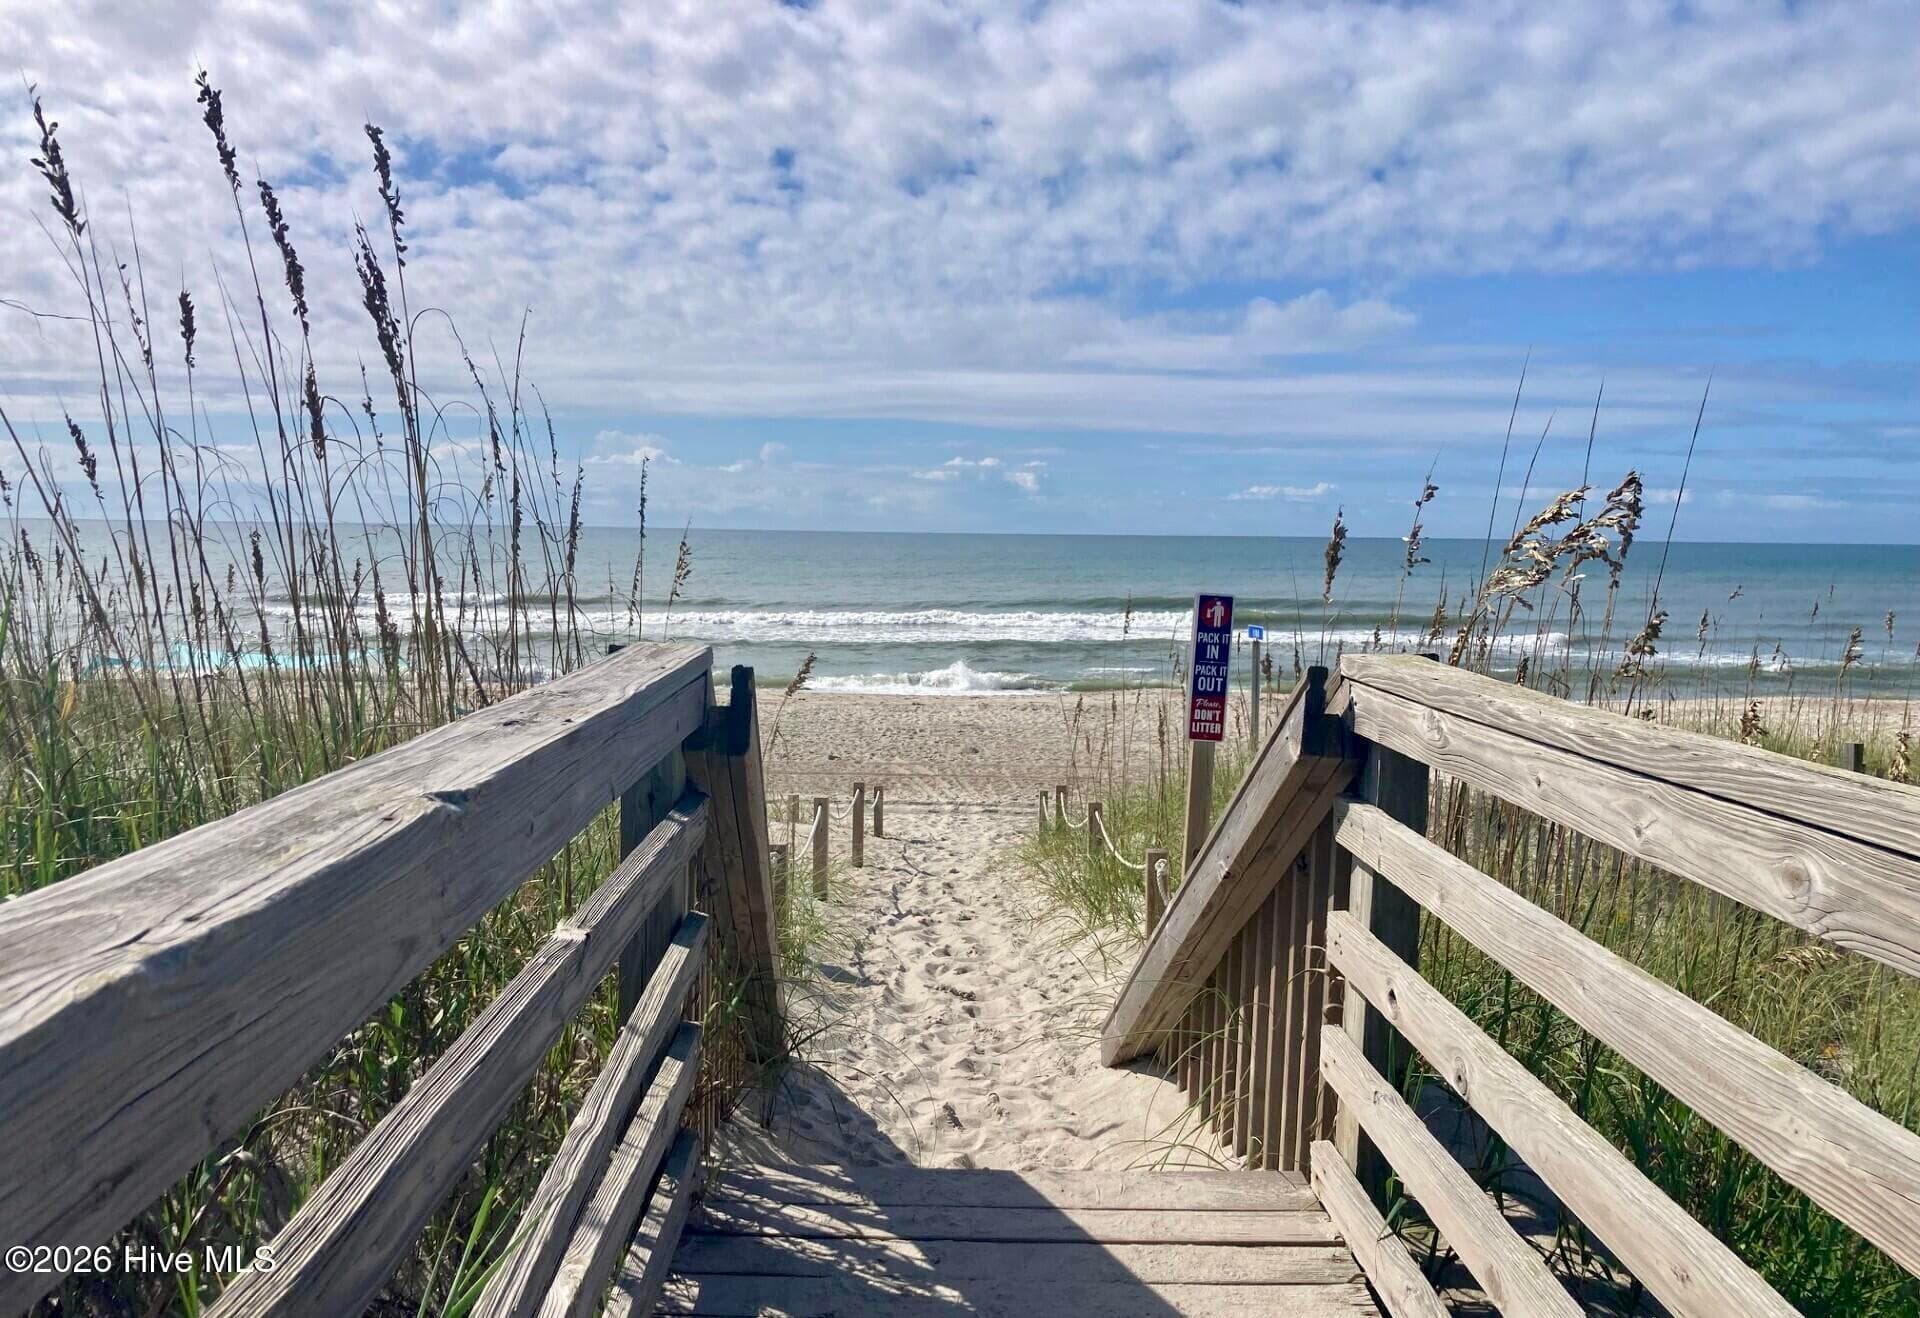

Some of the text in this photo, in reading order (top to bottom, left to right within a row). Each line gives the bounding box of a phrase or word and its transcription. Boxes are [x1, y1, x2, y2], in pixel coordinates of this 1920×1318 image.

[1198, 632, 1230, 644] PACK IT
[1206, 645, 1219, 659] IN
[1195, 664, 1228, 676] PACK IT
[1198, 676, 1224, 692] OUT
[1194, 709, 1222, 721] DON'T
[1192, 722, 1222, 734] LITTER
